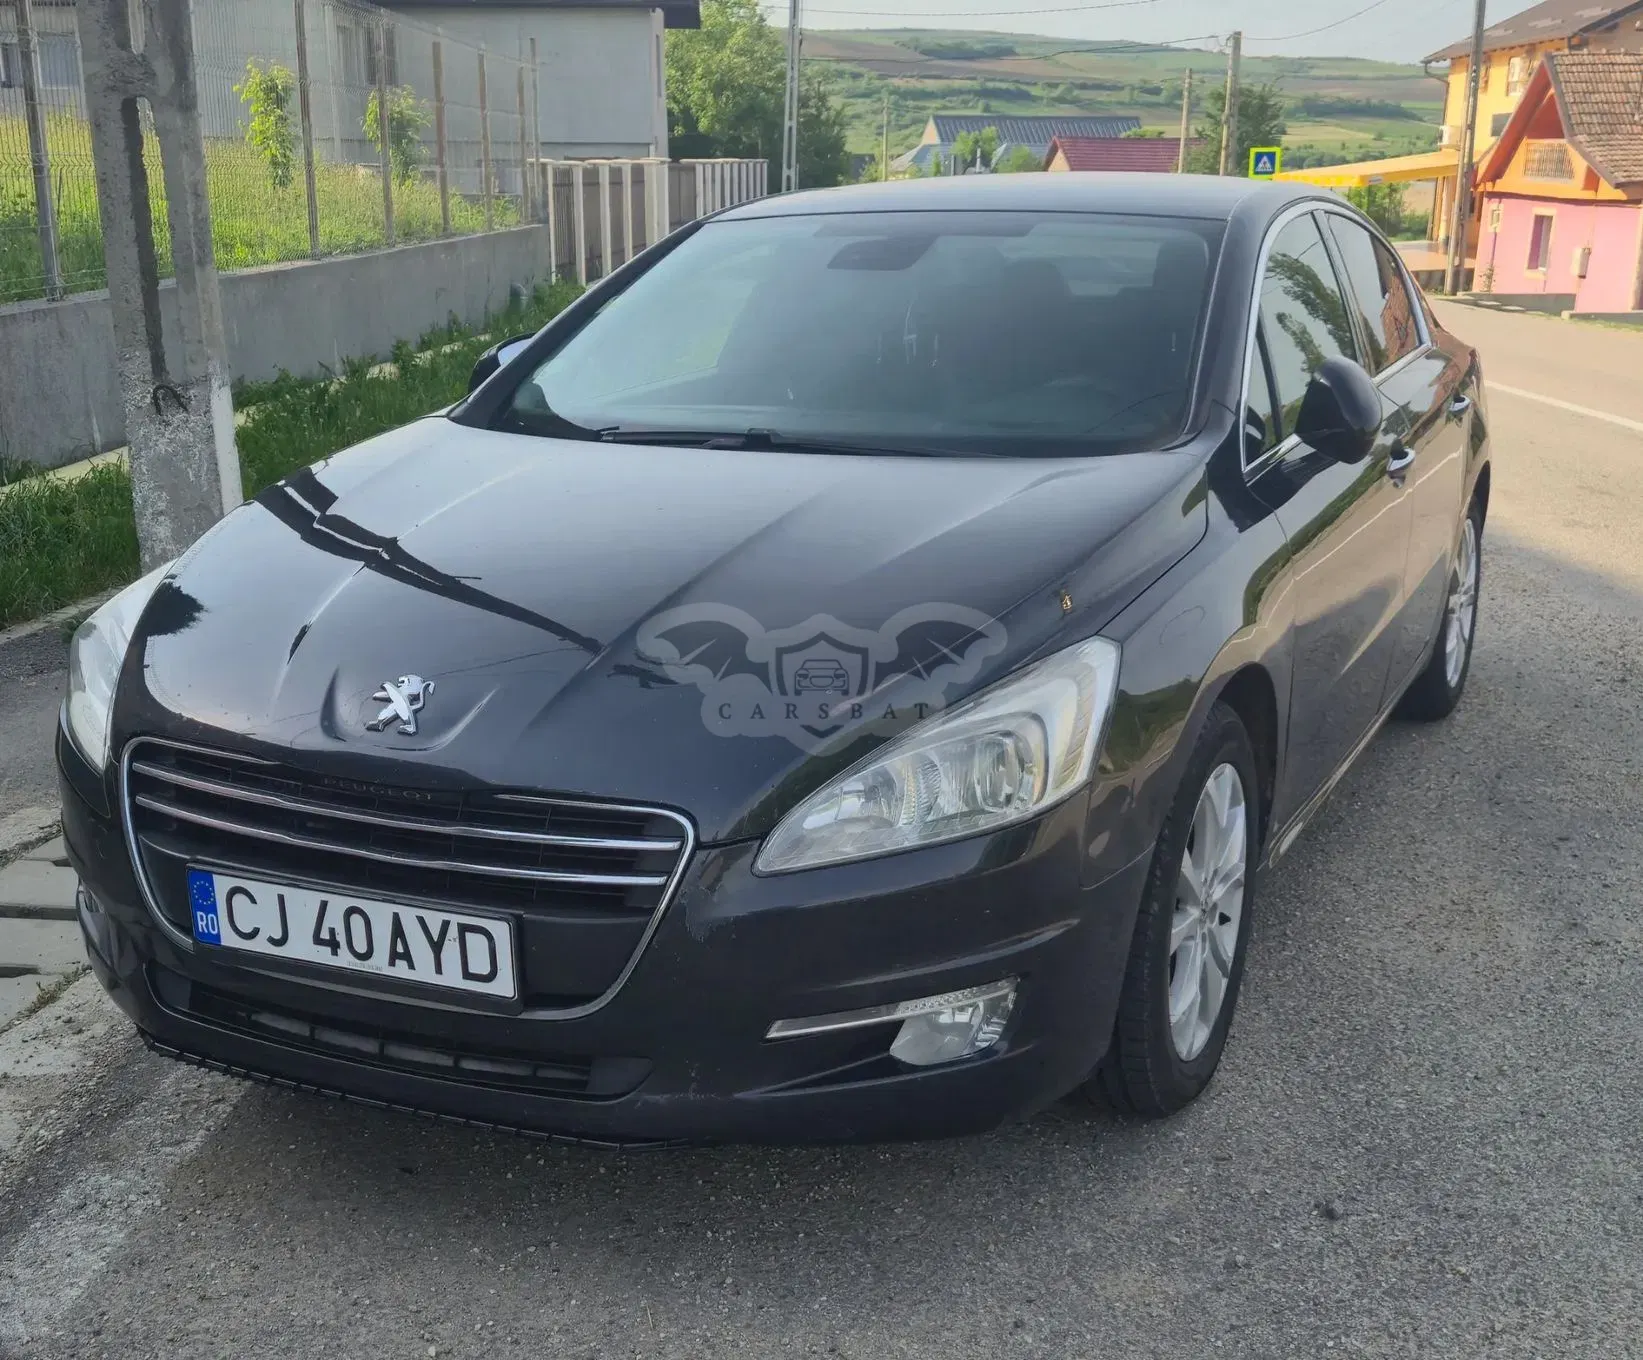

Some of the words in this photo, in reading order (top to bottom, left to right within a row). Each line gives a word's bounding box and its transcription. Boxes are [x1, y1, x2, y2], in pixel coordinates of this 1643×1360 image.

[196, 911, 218, 935] RO
[226, 886, 289, 947] CJ
[312, 900, 374, 961] 40
[388, 911, 498, 983] AYD
